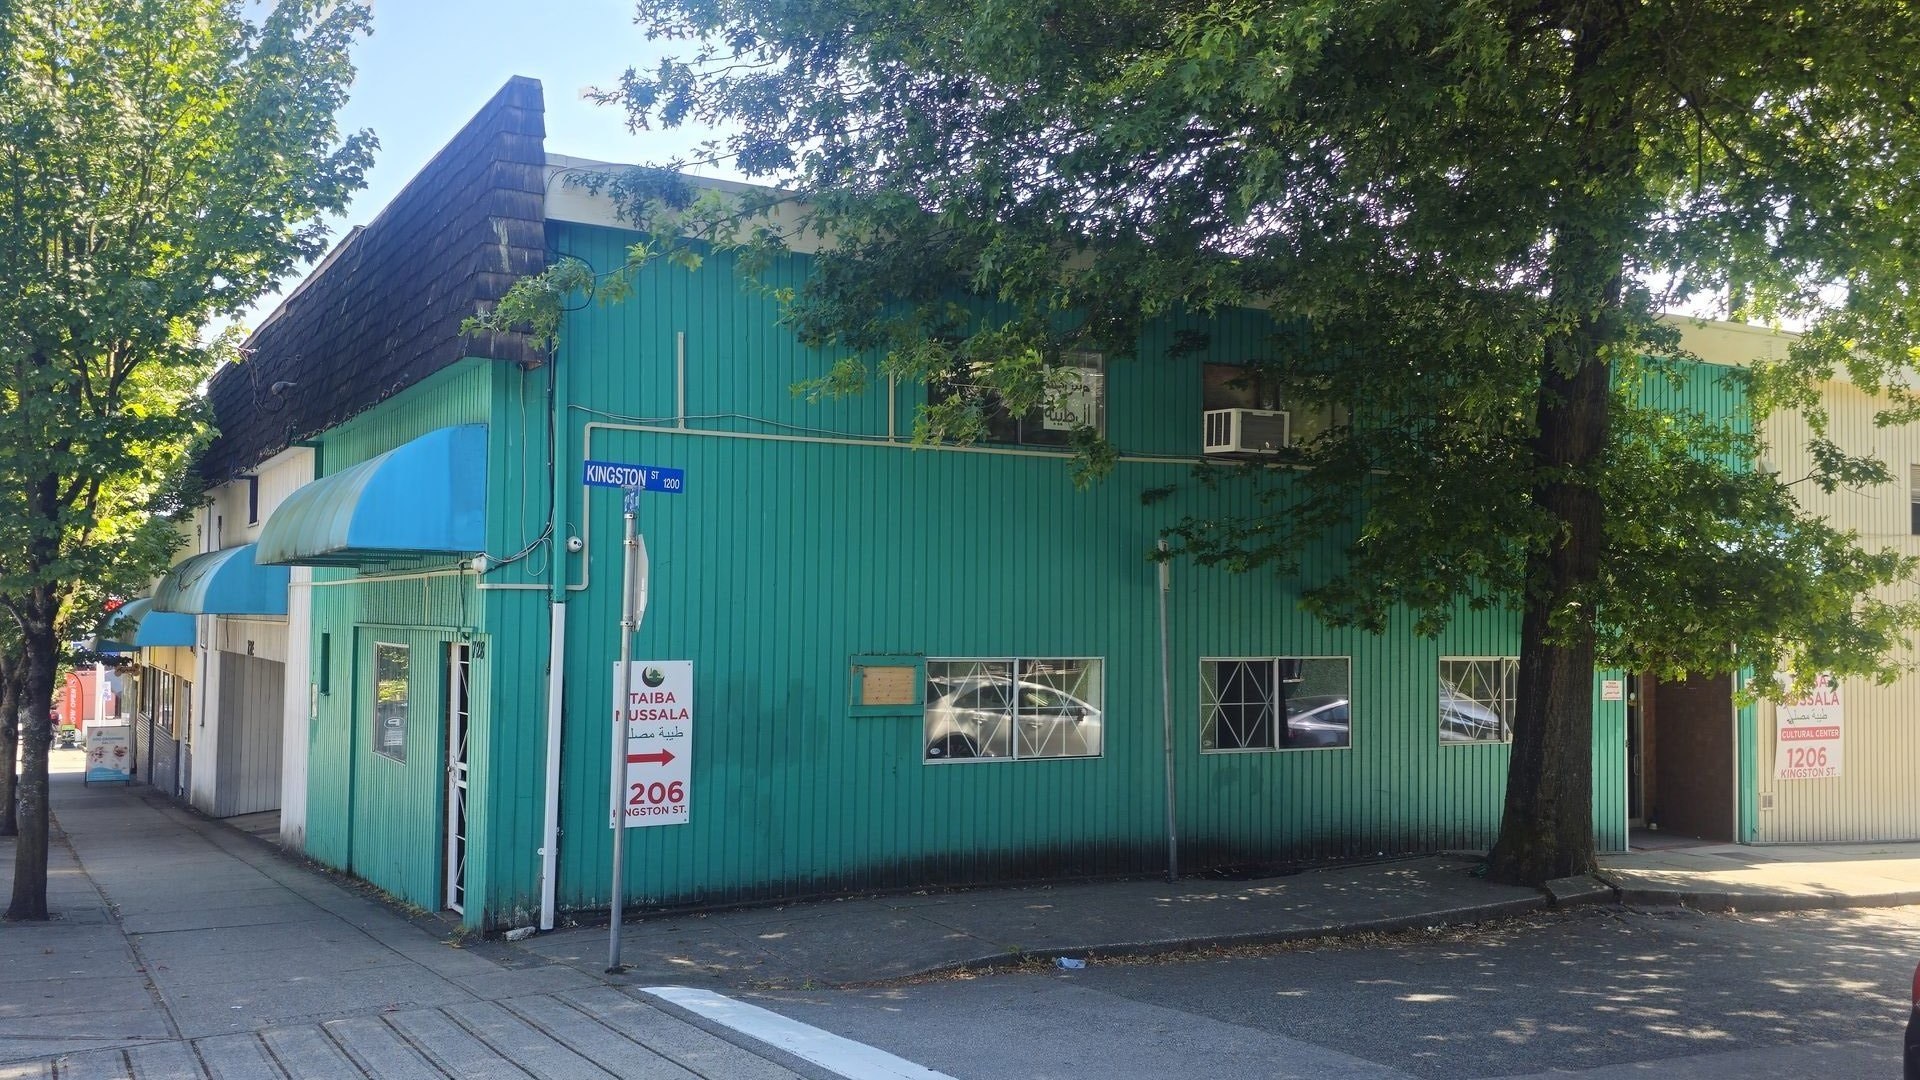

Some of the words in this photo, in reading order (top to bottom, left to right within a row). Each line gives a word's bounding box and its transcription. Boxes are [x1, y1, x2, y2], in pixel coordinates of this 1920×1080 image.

[586, 464, 647, 486] KINGSTON
[651, 470, 659, 480] ST
[663, 478, 680, 489] 1200
[630, 692, 676, 704] TAIBA
[628, 728, 654, 739] مصل
[1782, 730, 1814, 739] CULTURAL
[1815, 729, 1839, 738] CENTER
[1787, 747, 1827, 768] 1206
[1781, 768, 1824, 778] KINGSTON
[1826, 766, 1836, 776] ST.
[629, 781, 684, 805] 206
[612, 806, 669, 818] NGSTON
[673, 804, 687, 815] ST.
